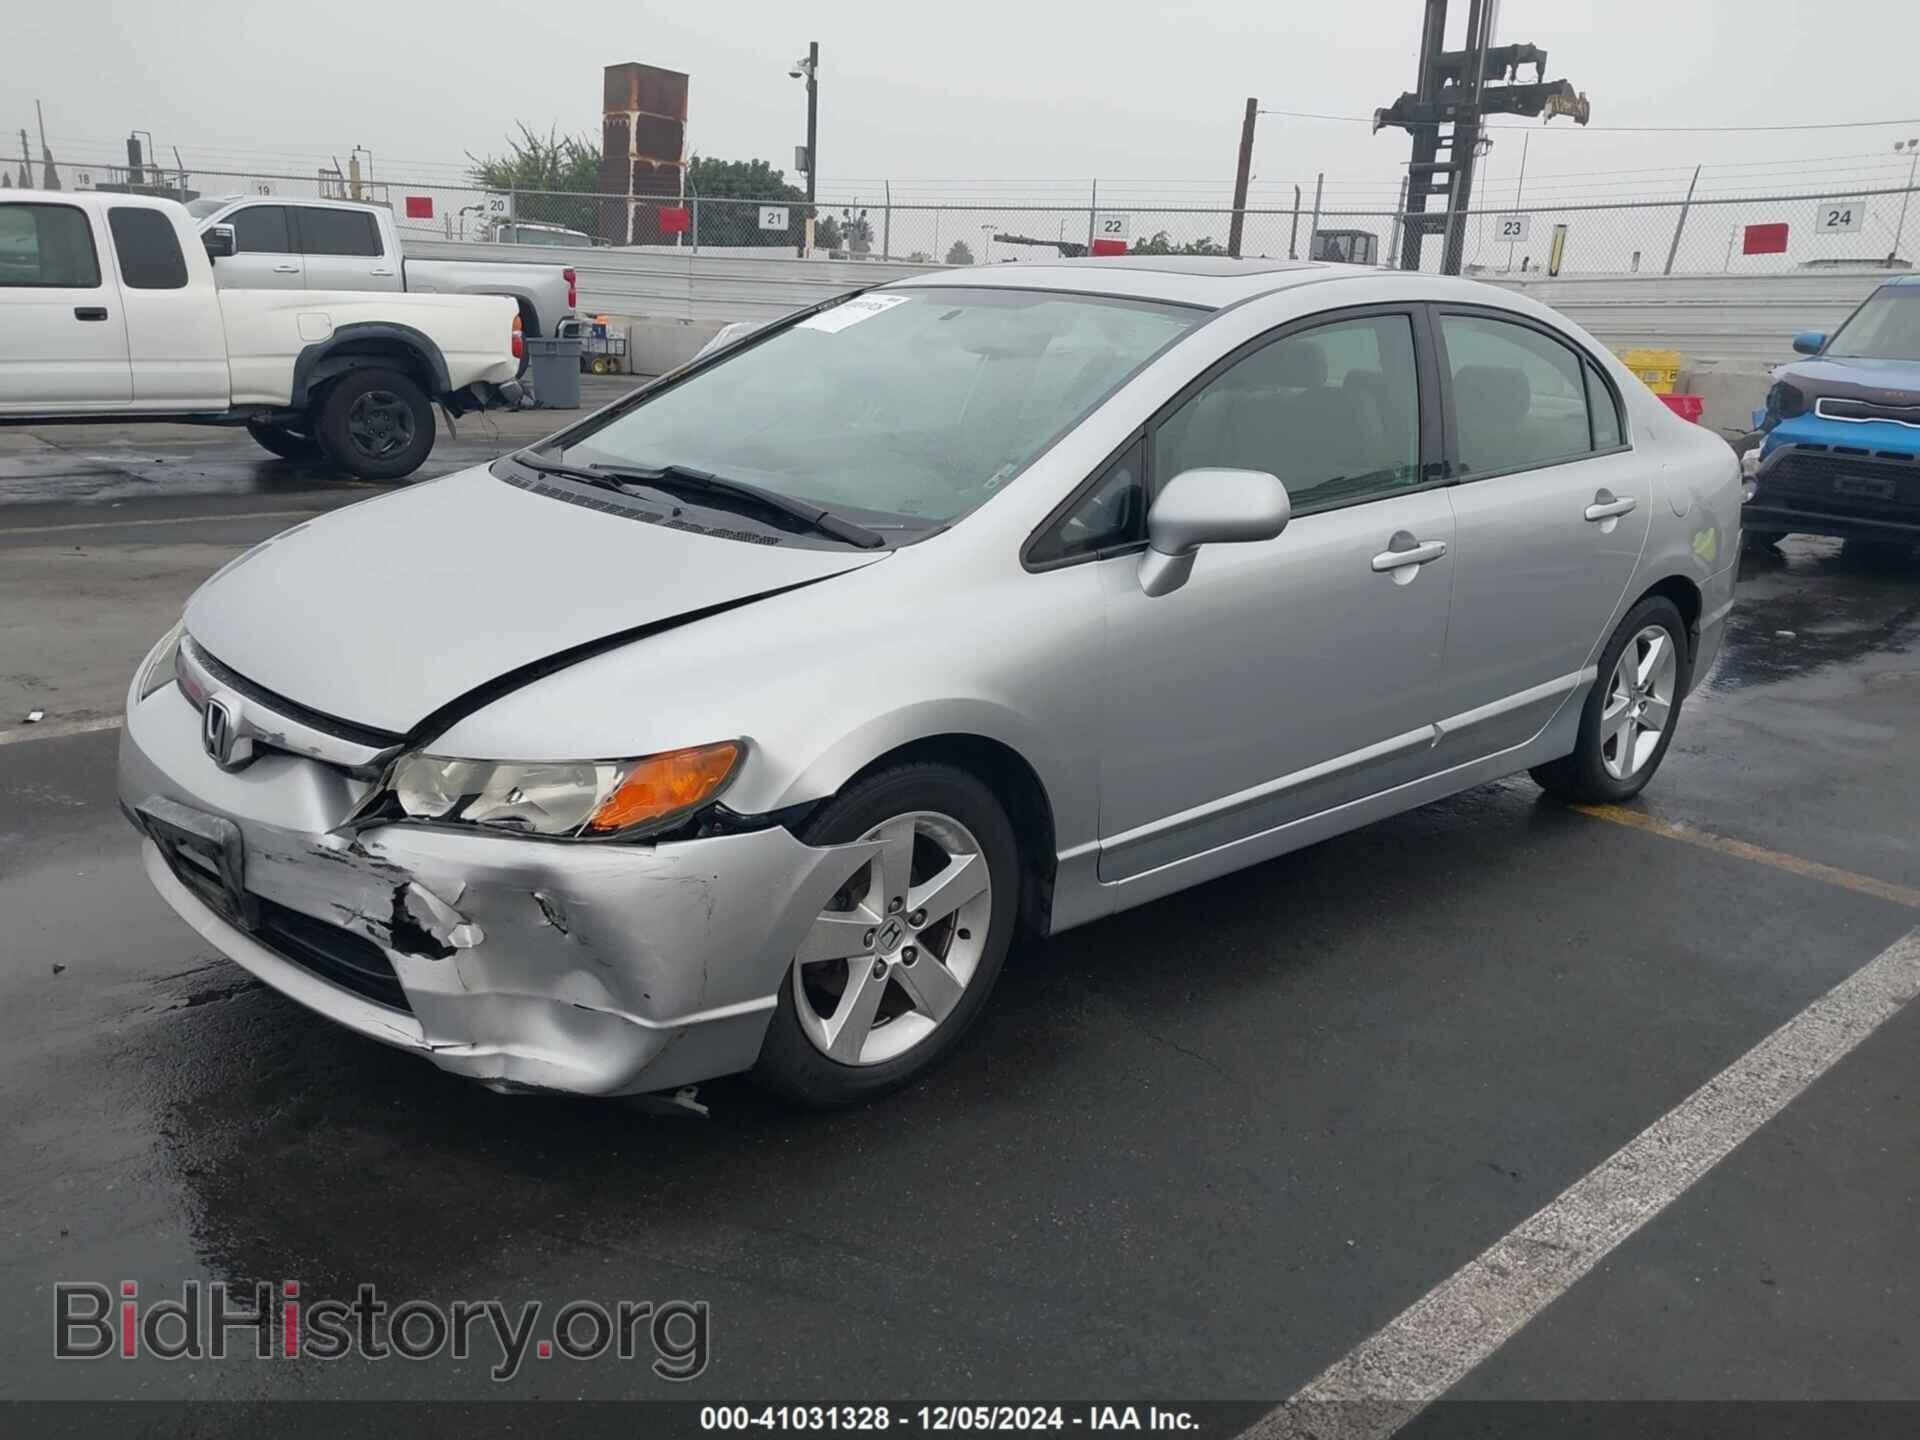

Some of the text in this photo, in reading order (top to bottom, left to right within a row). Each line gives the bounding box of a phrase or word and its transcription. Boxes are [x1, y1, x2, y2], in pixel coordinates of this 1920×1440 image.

[77, 173, 90, 185] 18
[258, 185, 270, 197] 19
[490, 199, 505, 212] 20
[767, 212, 782, 225] 21
[1826, 209, 1852, 227] 24
[1104, 219, 1122, 233] 22
[1503, 221, 1521, 236] 23
